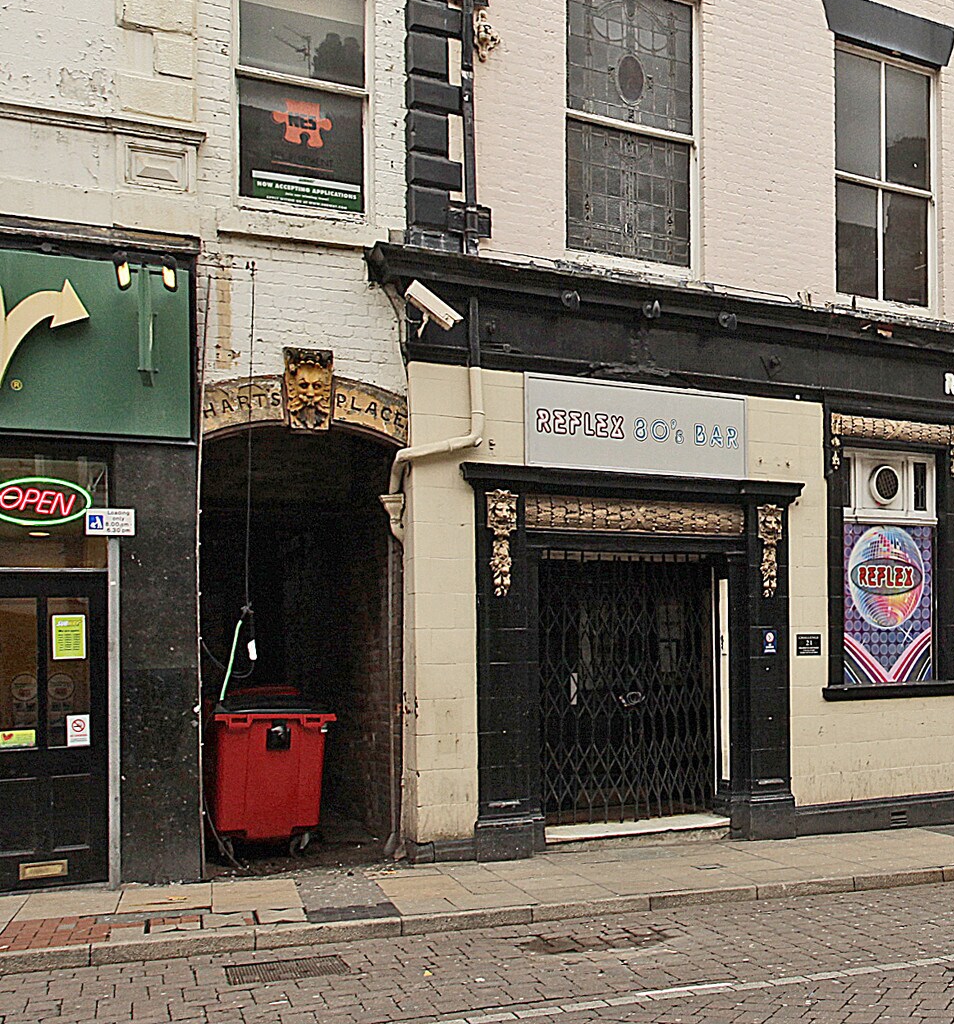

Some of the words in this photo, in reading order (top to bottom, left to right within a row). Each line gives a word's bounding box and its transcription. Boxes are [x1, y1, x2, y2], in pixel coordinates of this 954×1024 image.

[288, 114, 317, 131] NES
[256, 180, 273, 188] NOW
[274, 183, 311, 193] ACCEPTING
[312, 188, 357, 200] APPLICATIONS
[203, 391, 282, 419] HARTS
[336, 393, 408, 430] PLACE
[536, 407, 625, 440] REFLEX
[633, 416, 685, 444] 80's
[693, 422, 739, 449] BAR
[0, 486, 76, 517] OPEN
[858, 565, 914, 588] REFLEX
